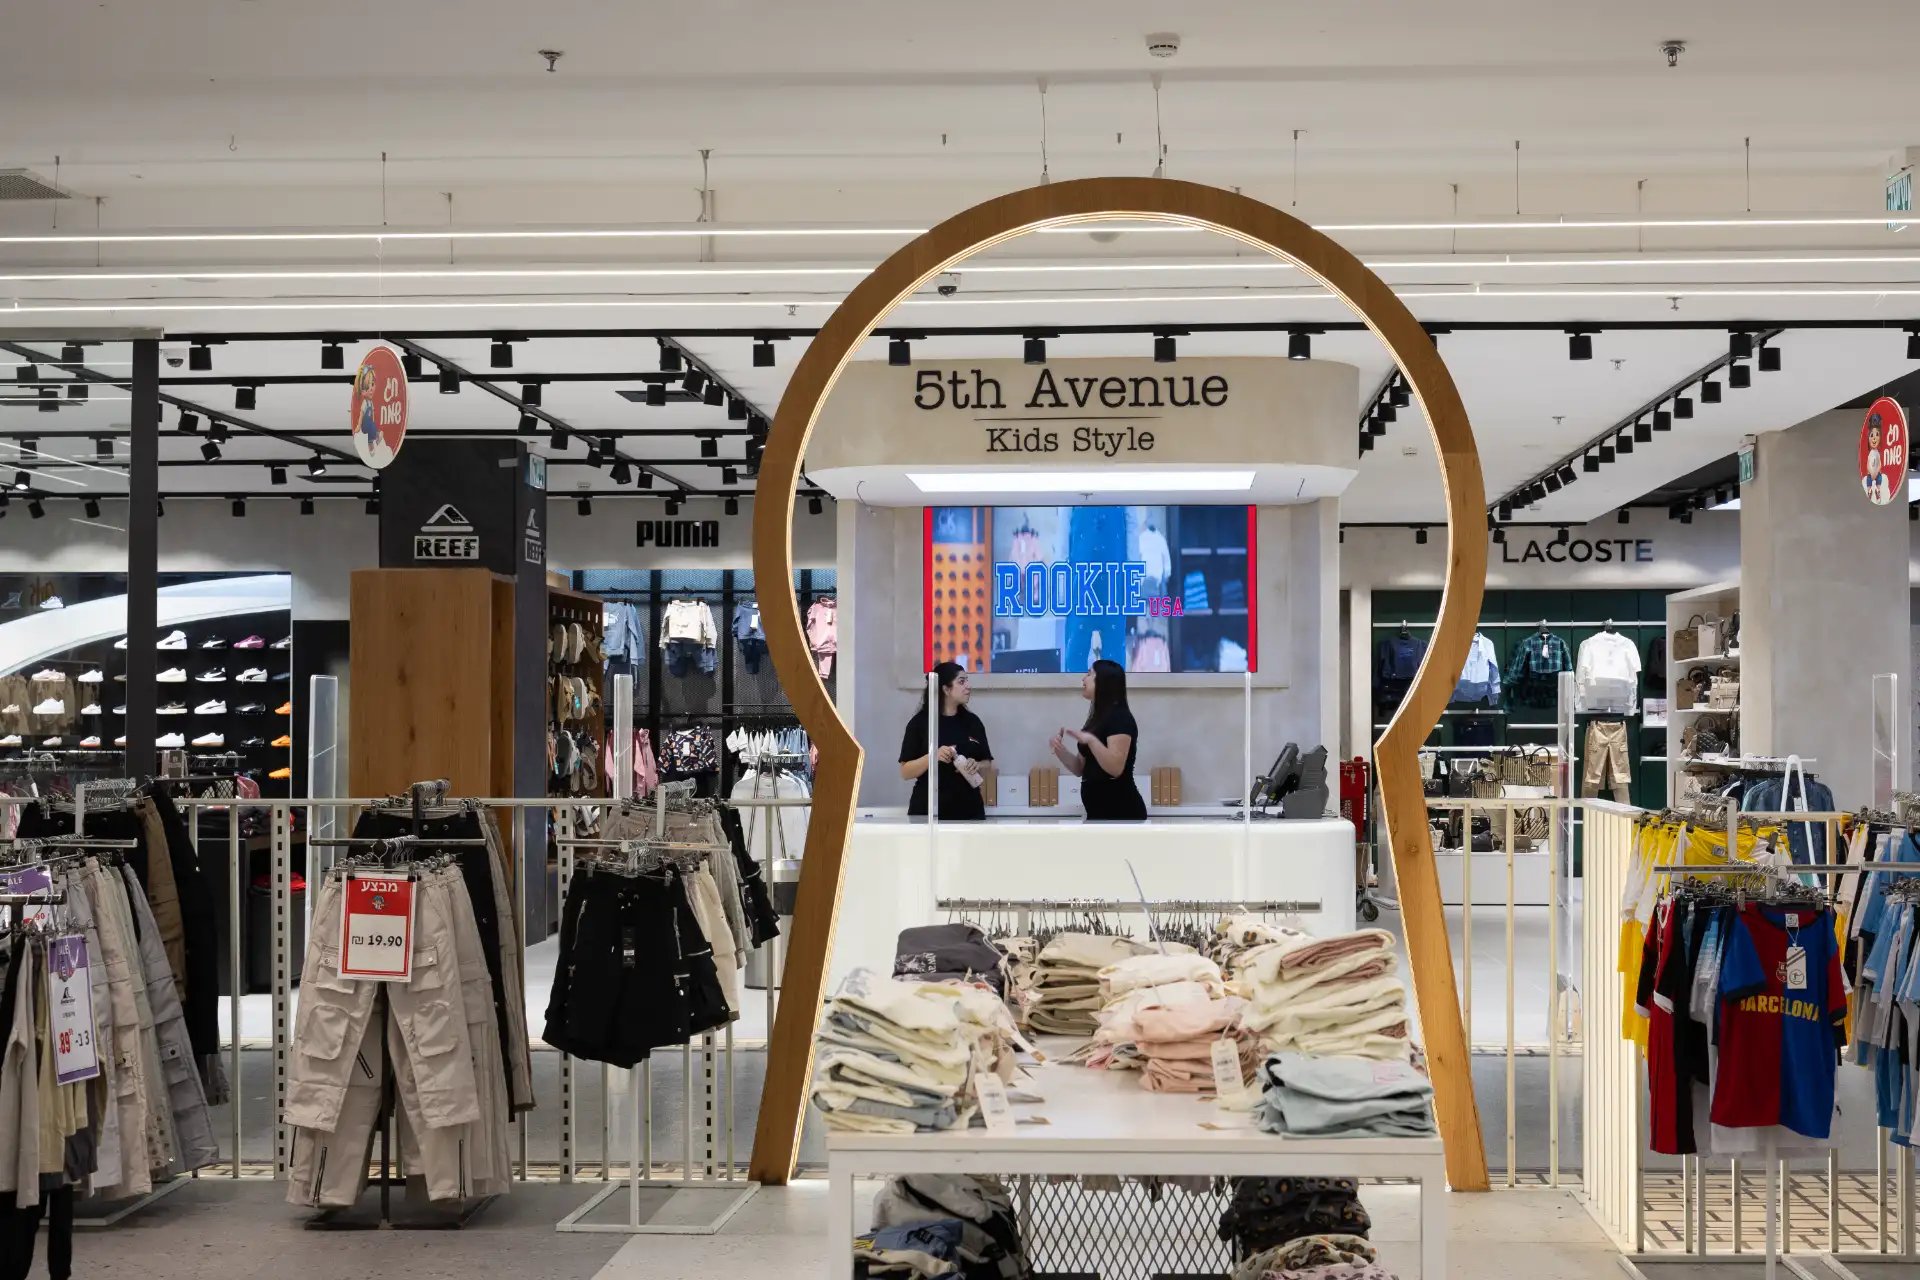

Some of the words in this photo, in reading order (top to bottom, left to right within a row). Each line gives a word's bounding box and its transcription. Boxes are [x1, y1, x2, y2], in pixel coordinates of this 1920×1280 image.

[914, 369, 1006, 410] 5th
[1025, 368, 1228, 408] Avenue
[986, 427, 1059, 452] Kids
[1073, 427, 1155, 457] Style
[637, 520, 719, 547] PUMA
[416, 538, 477, 557] REEF
[1502, 540, 1654, 563] LACOSTE
[995, 561, 1148, 617] ROOKIE
[1150, 597, 1184, 617] USA
[361, 881, 398, 892] מבצע
[367, 935, 403, 947] 19.90
